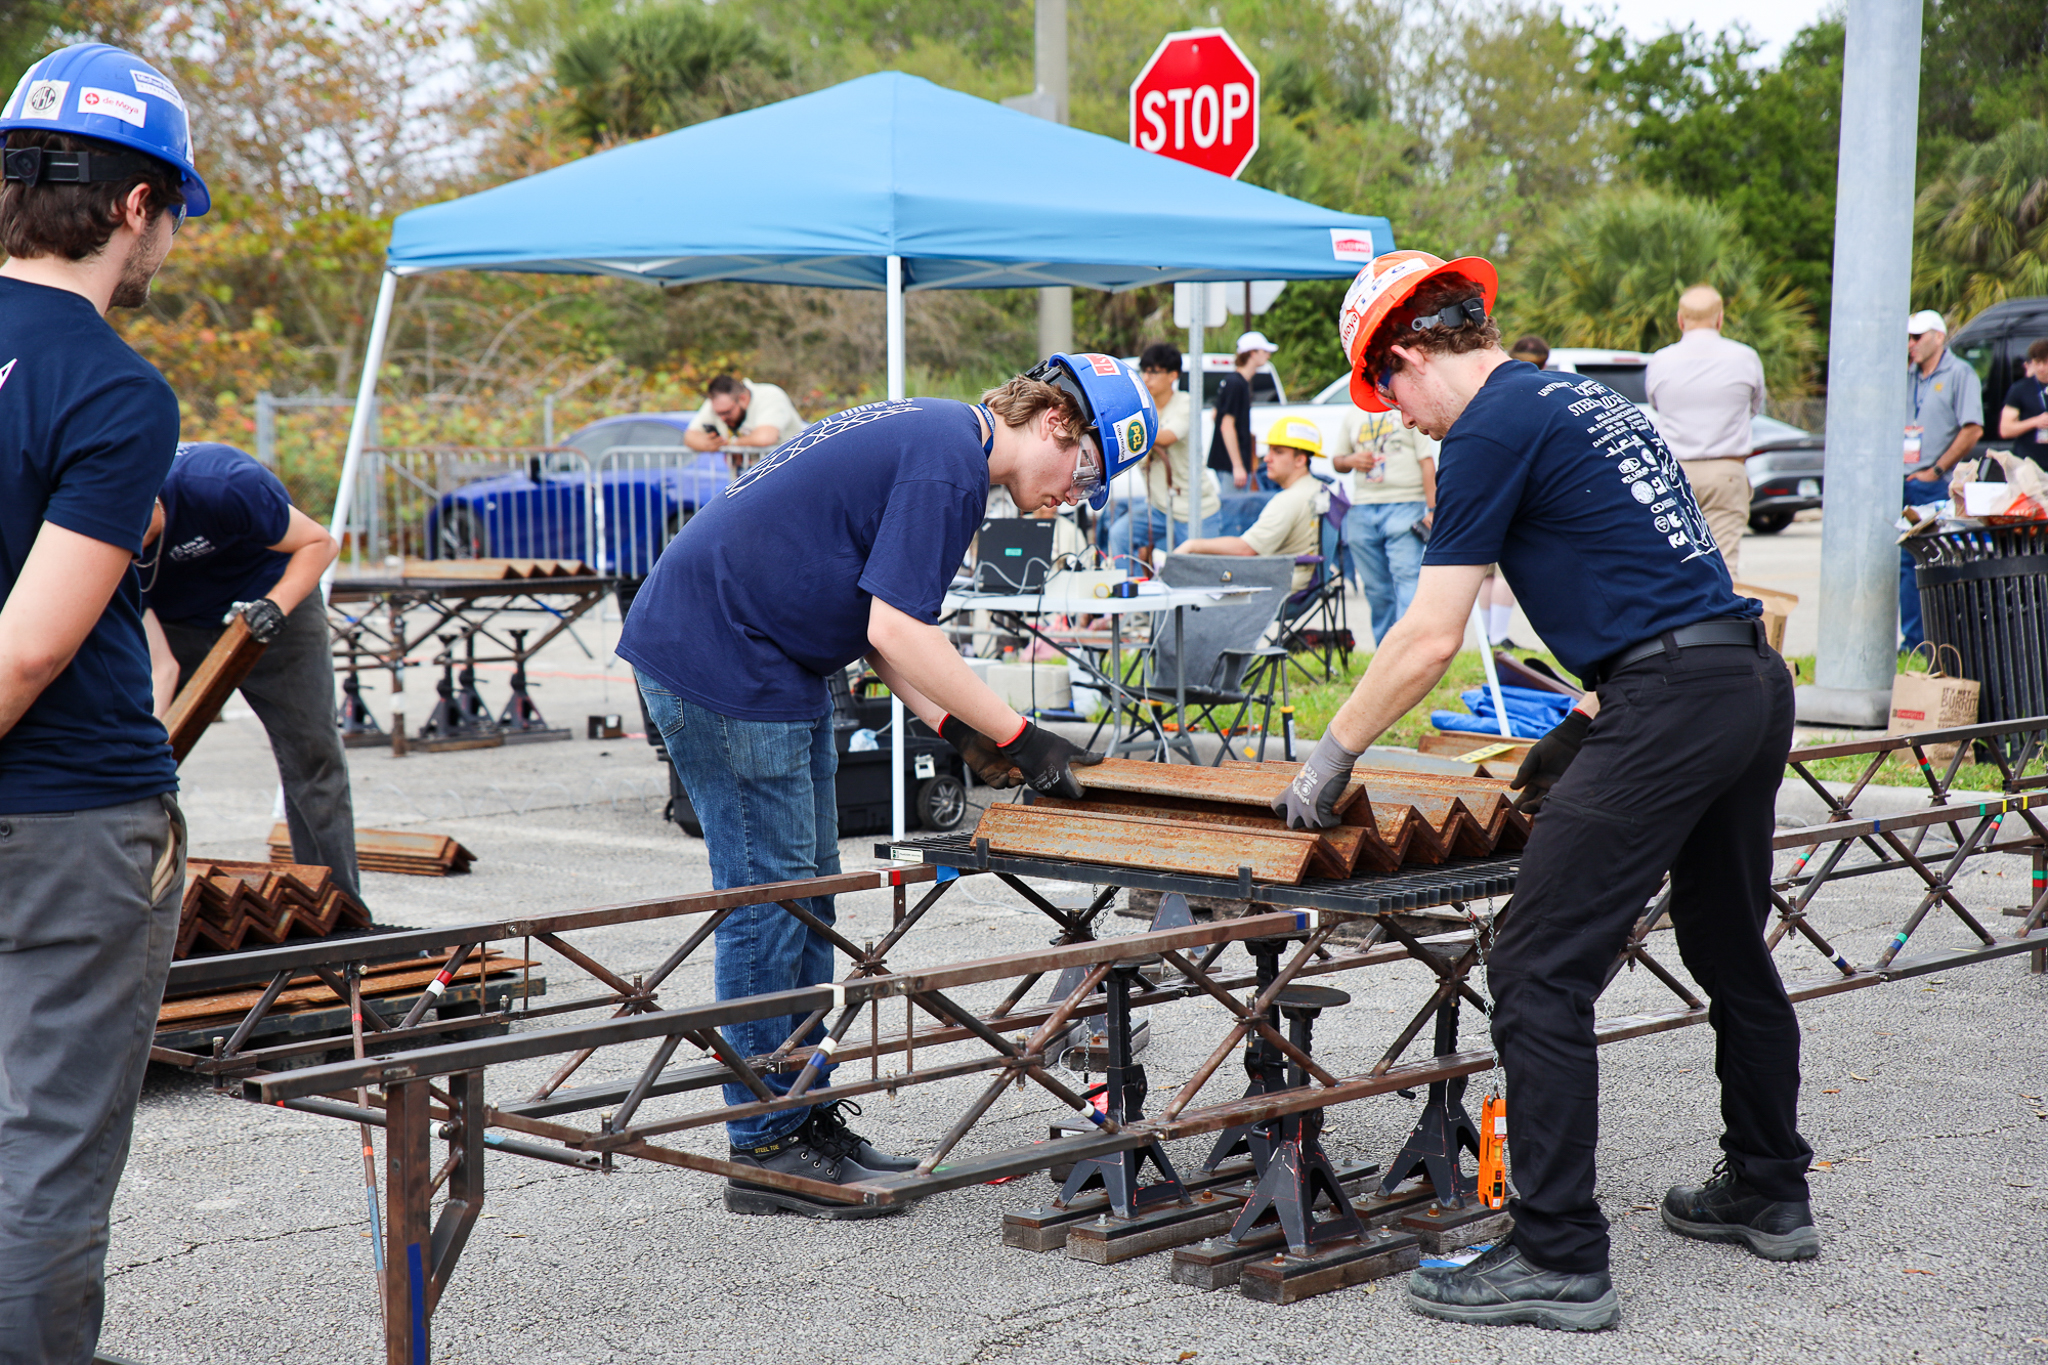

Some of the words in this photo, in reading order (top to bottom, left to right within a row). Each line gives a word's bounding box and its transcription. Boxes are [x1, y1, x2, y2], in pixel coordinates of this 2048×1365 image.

[32, 87, 55, 110] AISC
[115, 99, 139, 115] Moya
[1139, 82, 1250, 153] STOP
[1567, 397, 1600, 417] STEEL
[1131, 425, 1141, 452] PCL
[754, 1145, 769, 1154] STEEL
[769, 1143, 780, 1151] TOE
